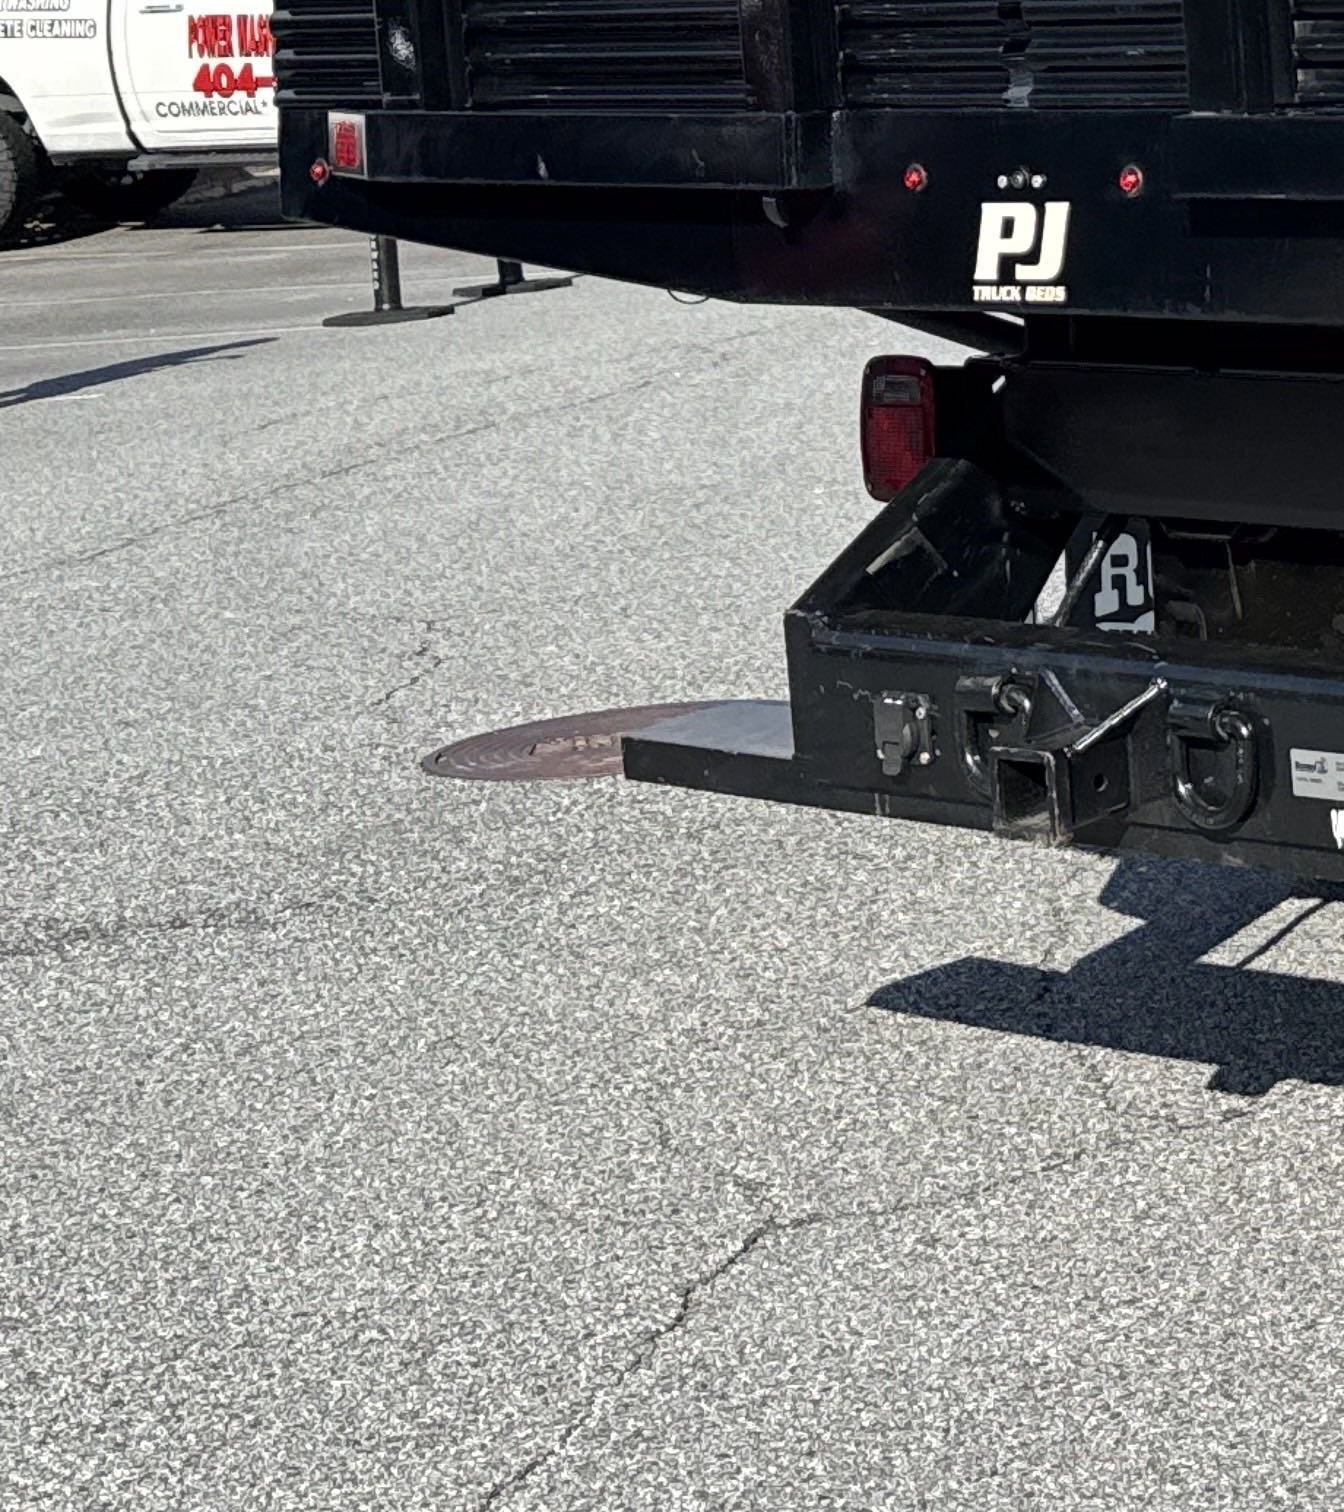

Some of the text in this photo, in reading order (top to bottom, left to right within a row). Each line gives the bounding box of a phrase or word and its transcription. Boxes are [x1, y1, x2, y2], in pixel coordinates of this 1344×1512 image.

[26, 19, 97, 39] CLEANING
[187, 14, 235, 58] POWER
[156, 99, 262, 118] COMMERCIAL
[974, 201, 1070, 280] PJ
